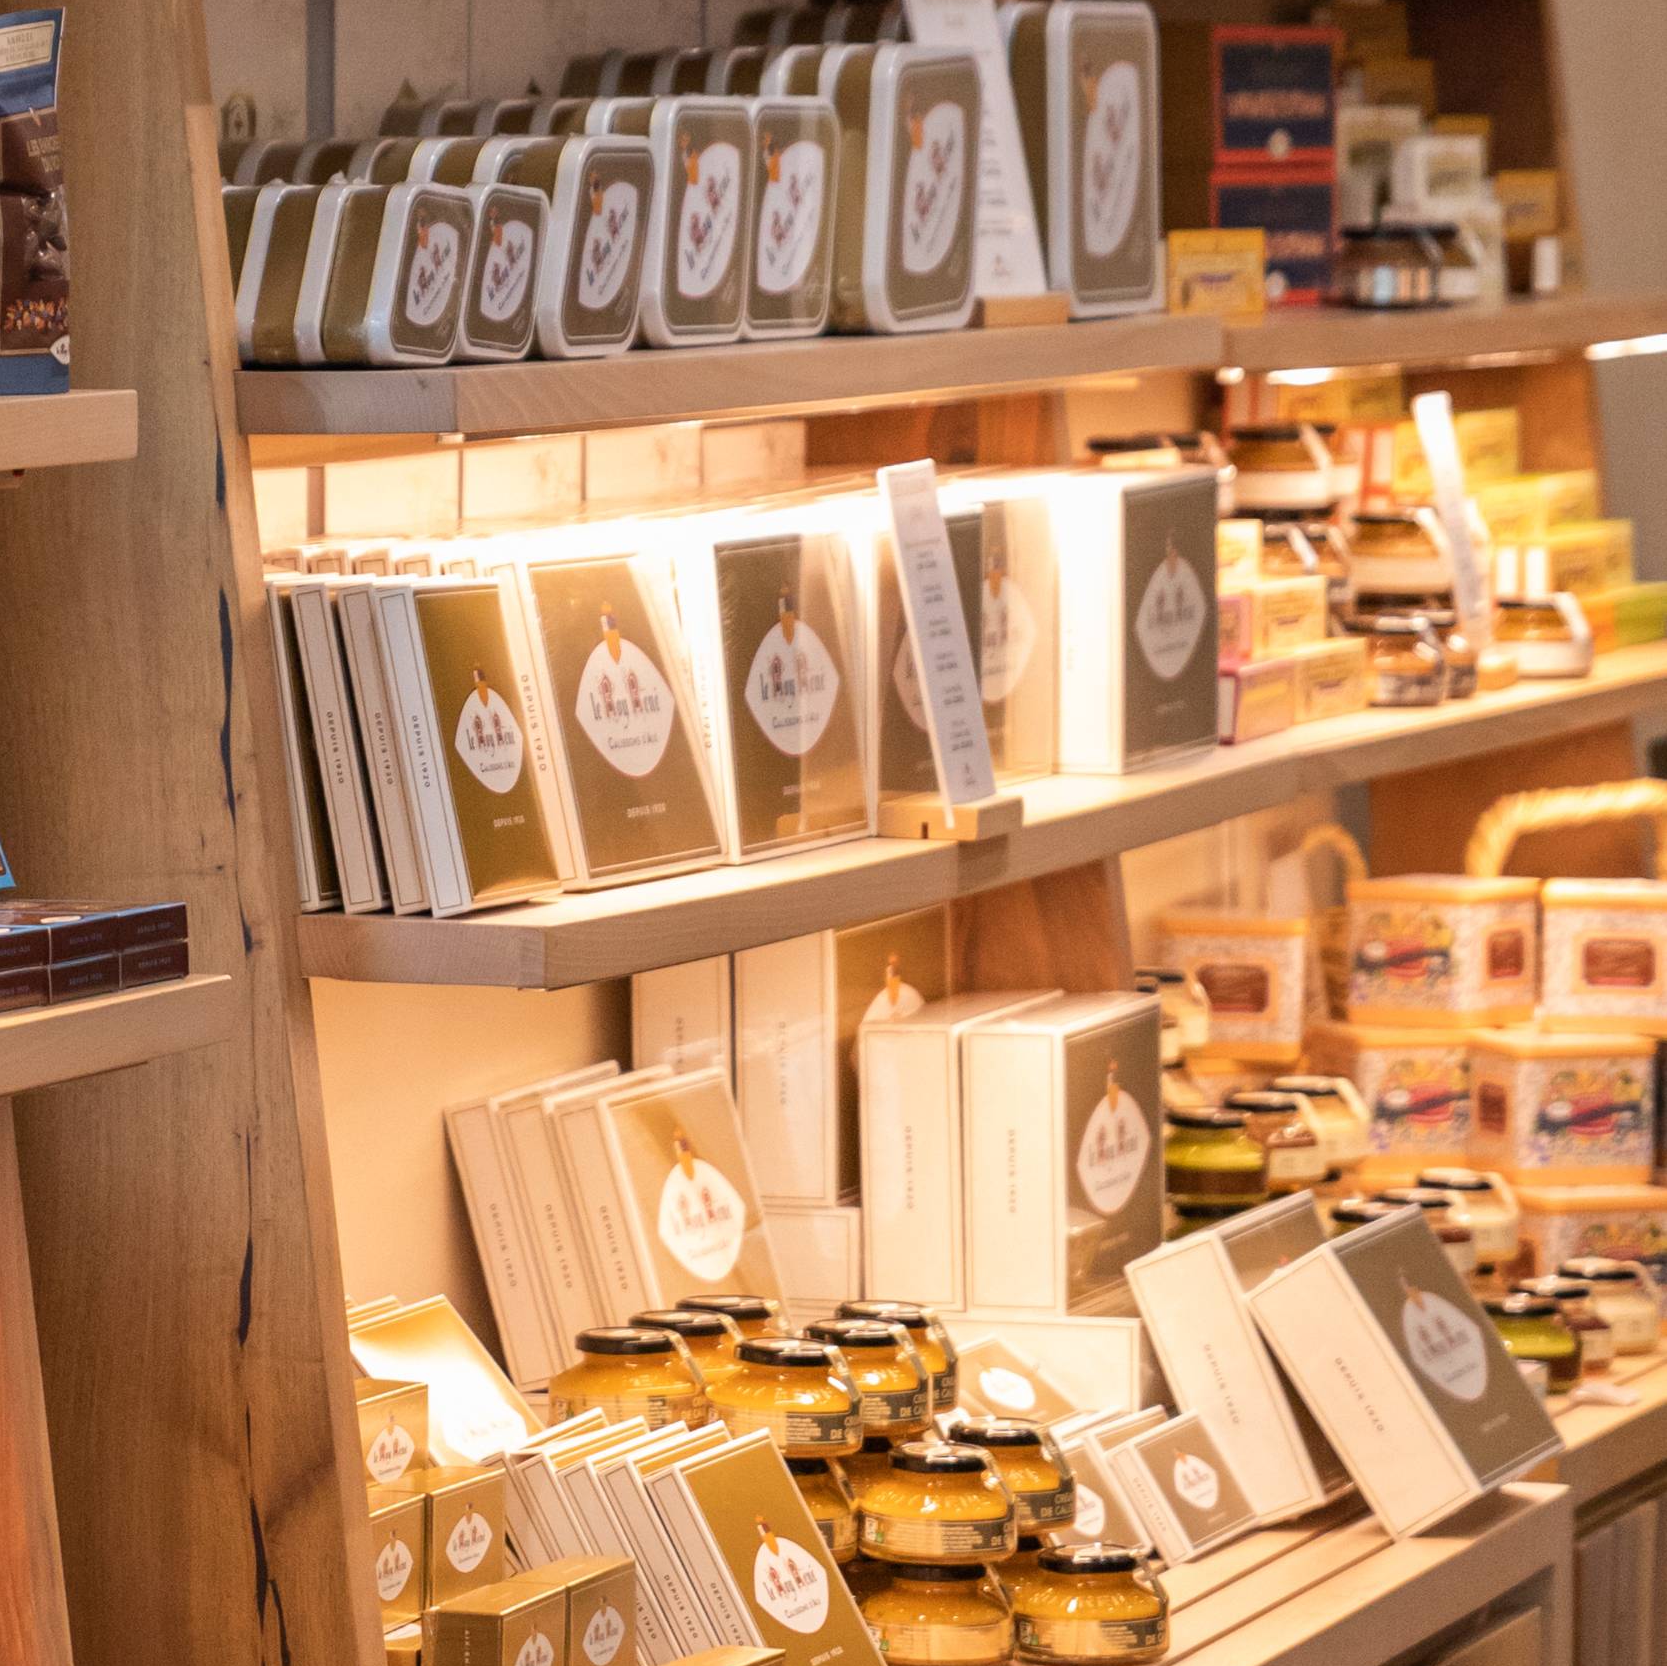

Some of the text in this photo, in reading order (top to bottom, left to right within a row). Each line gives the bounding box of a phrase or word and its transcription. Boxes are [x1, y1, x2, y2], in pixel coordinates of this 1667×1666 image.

[589, 669, 660, 730] le Roy René
[759, 653, 827, 710] le Roy René
[326, 711, 345, 785] DEPUIS 1920
[374, 712, 394, 786] DEPUIS 1920
[411, 715, 431, 789] DEPUIS 1920
[466, 710, 516, 757] le Roy René
[521, 673, 548, 773] DEPUIS 1920
[626, 802, 667, 819] DEPUIS 1920
[1039, 1506, 1053, 1518] DE
[663, 1574, 699, 1639] DEPUIS 1920
[762, 1557, 818, 1602] le Roy René
[710, 1582, 745, 1647] DEPUIS 1920
